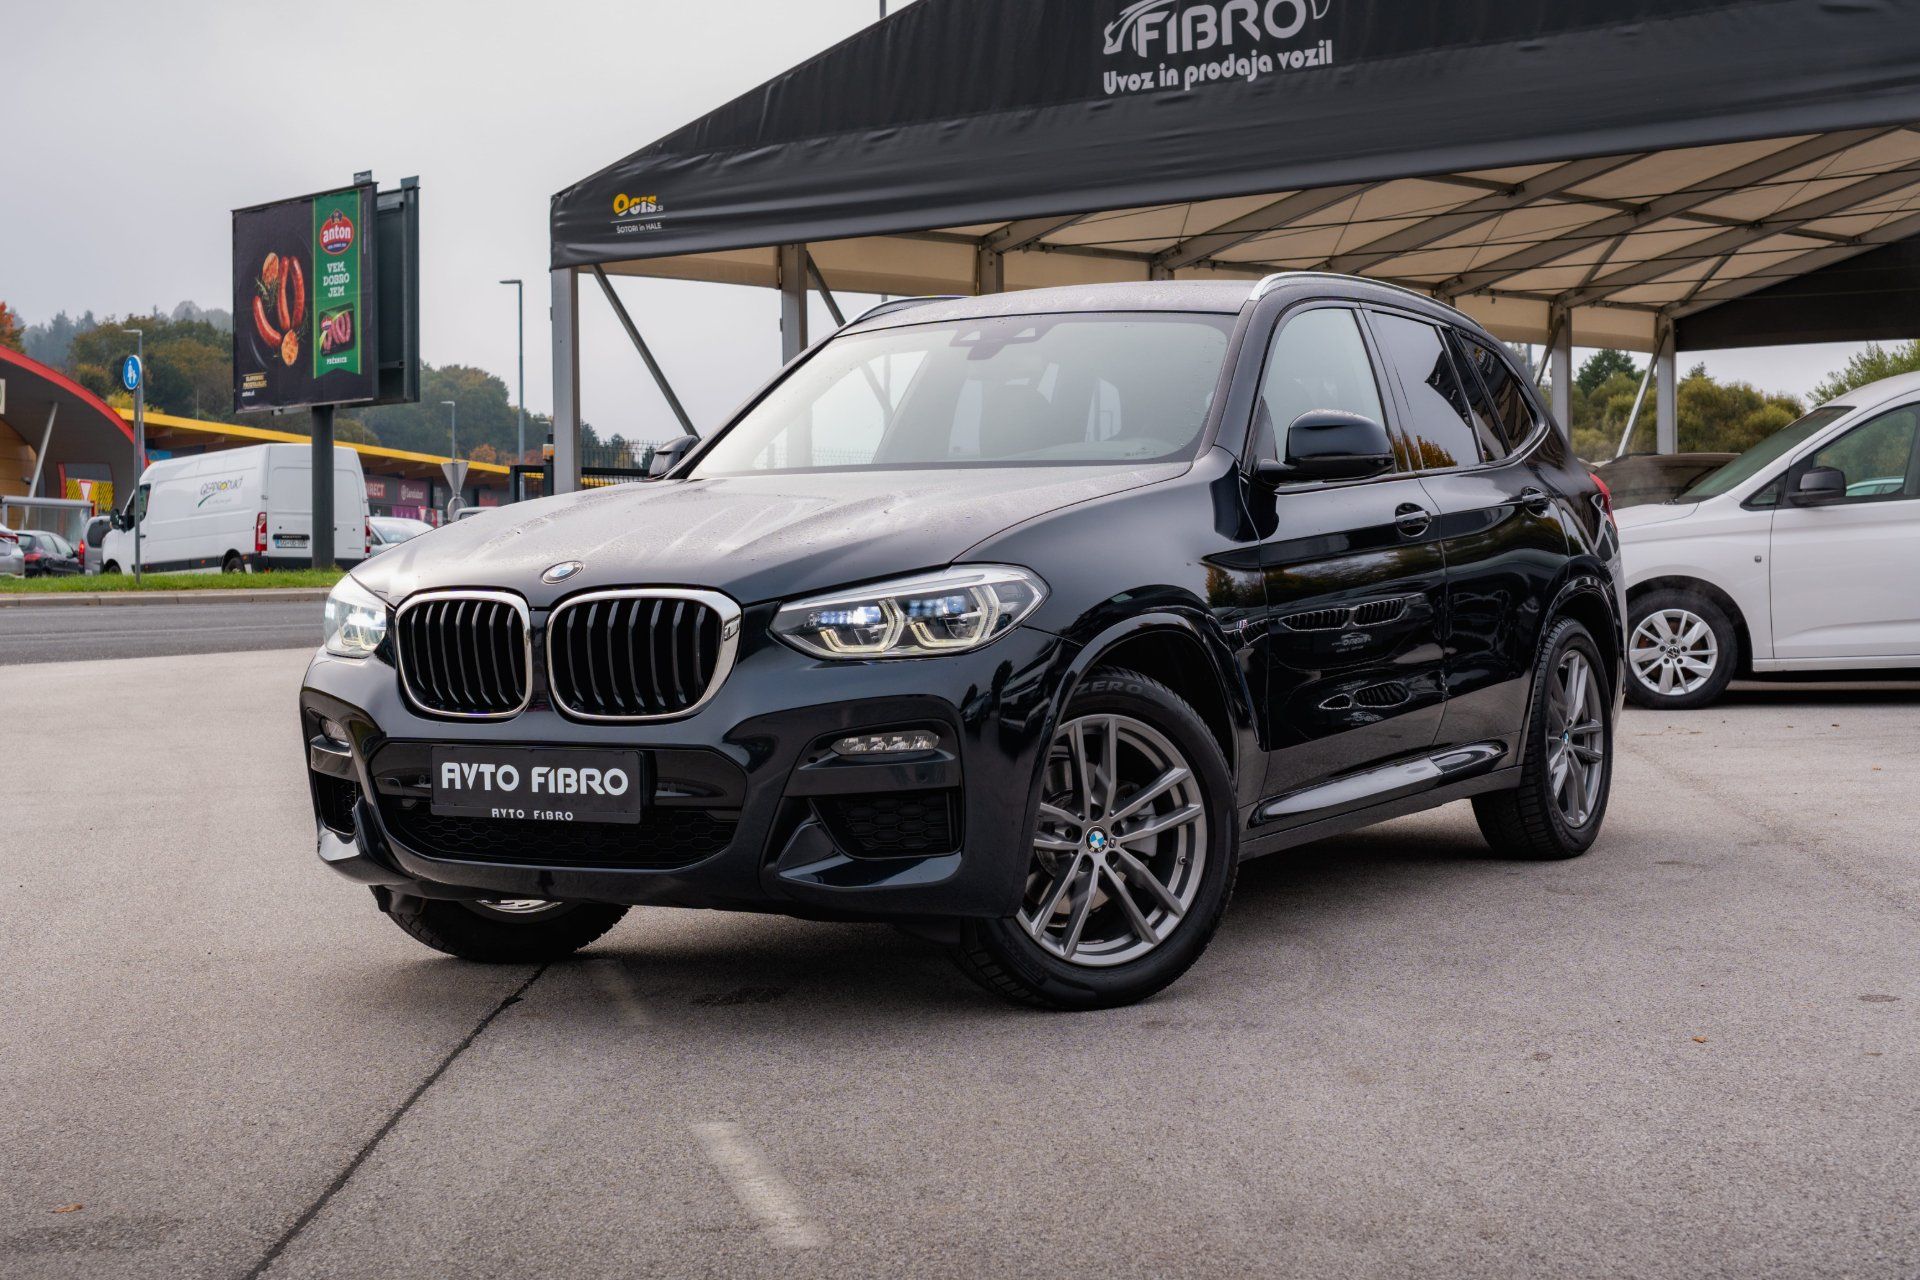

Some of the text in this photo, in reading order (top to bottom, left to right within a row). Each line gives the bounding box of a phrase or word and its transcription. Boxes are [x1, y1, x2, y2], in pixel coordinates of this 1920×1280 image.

[1132, 0, 1307, 57] FIBRO
[1103, 39, 1333, 94] Uvoz in prodaja vozil
[322, 225, 352, 243] anton
[646, 222, 662, 230] HALE
[326, 261, 346, 273] VEM,
[323, 272, 350, 287] DOBRO
[327, 286, 345, 298] JEM
[1074, 680, 1144, 697] ZERO
[441, 762, 629, 796] AVTO FIBRO
[491, 808, 574, 821] AVTO FIBRO
